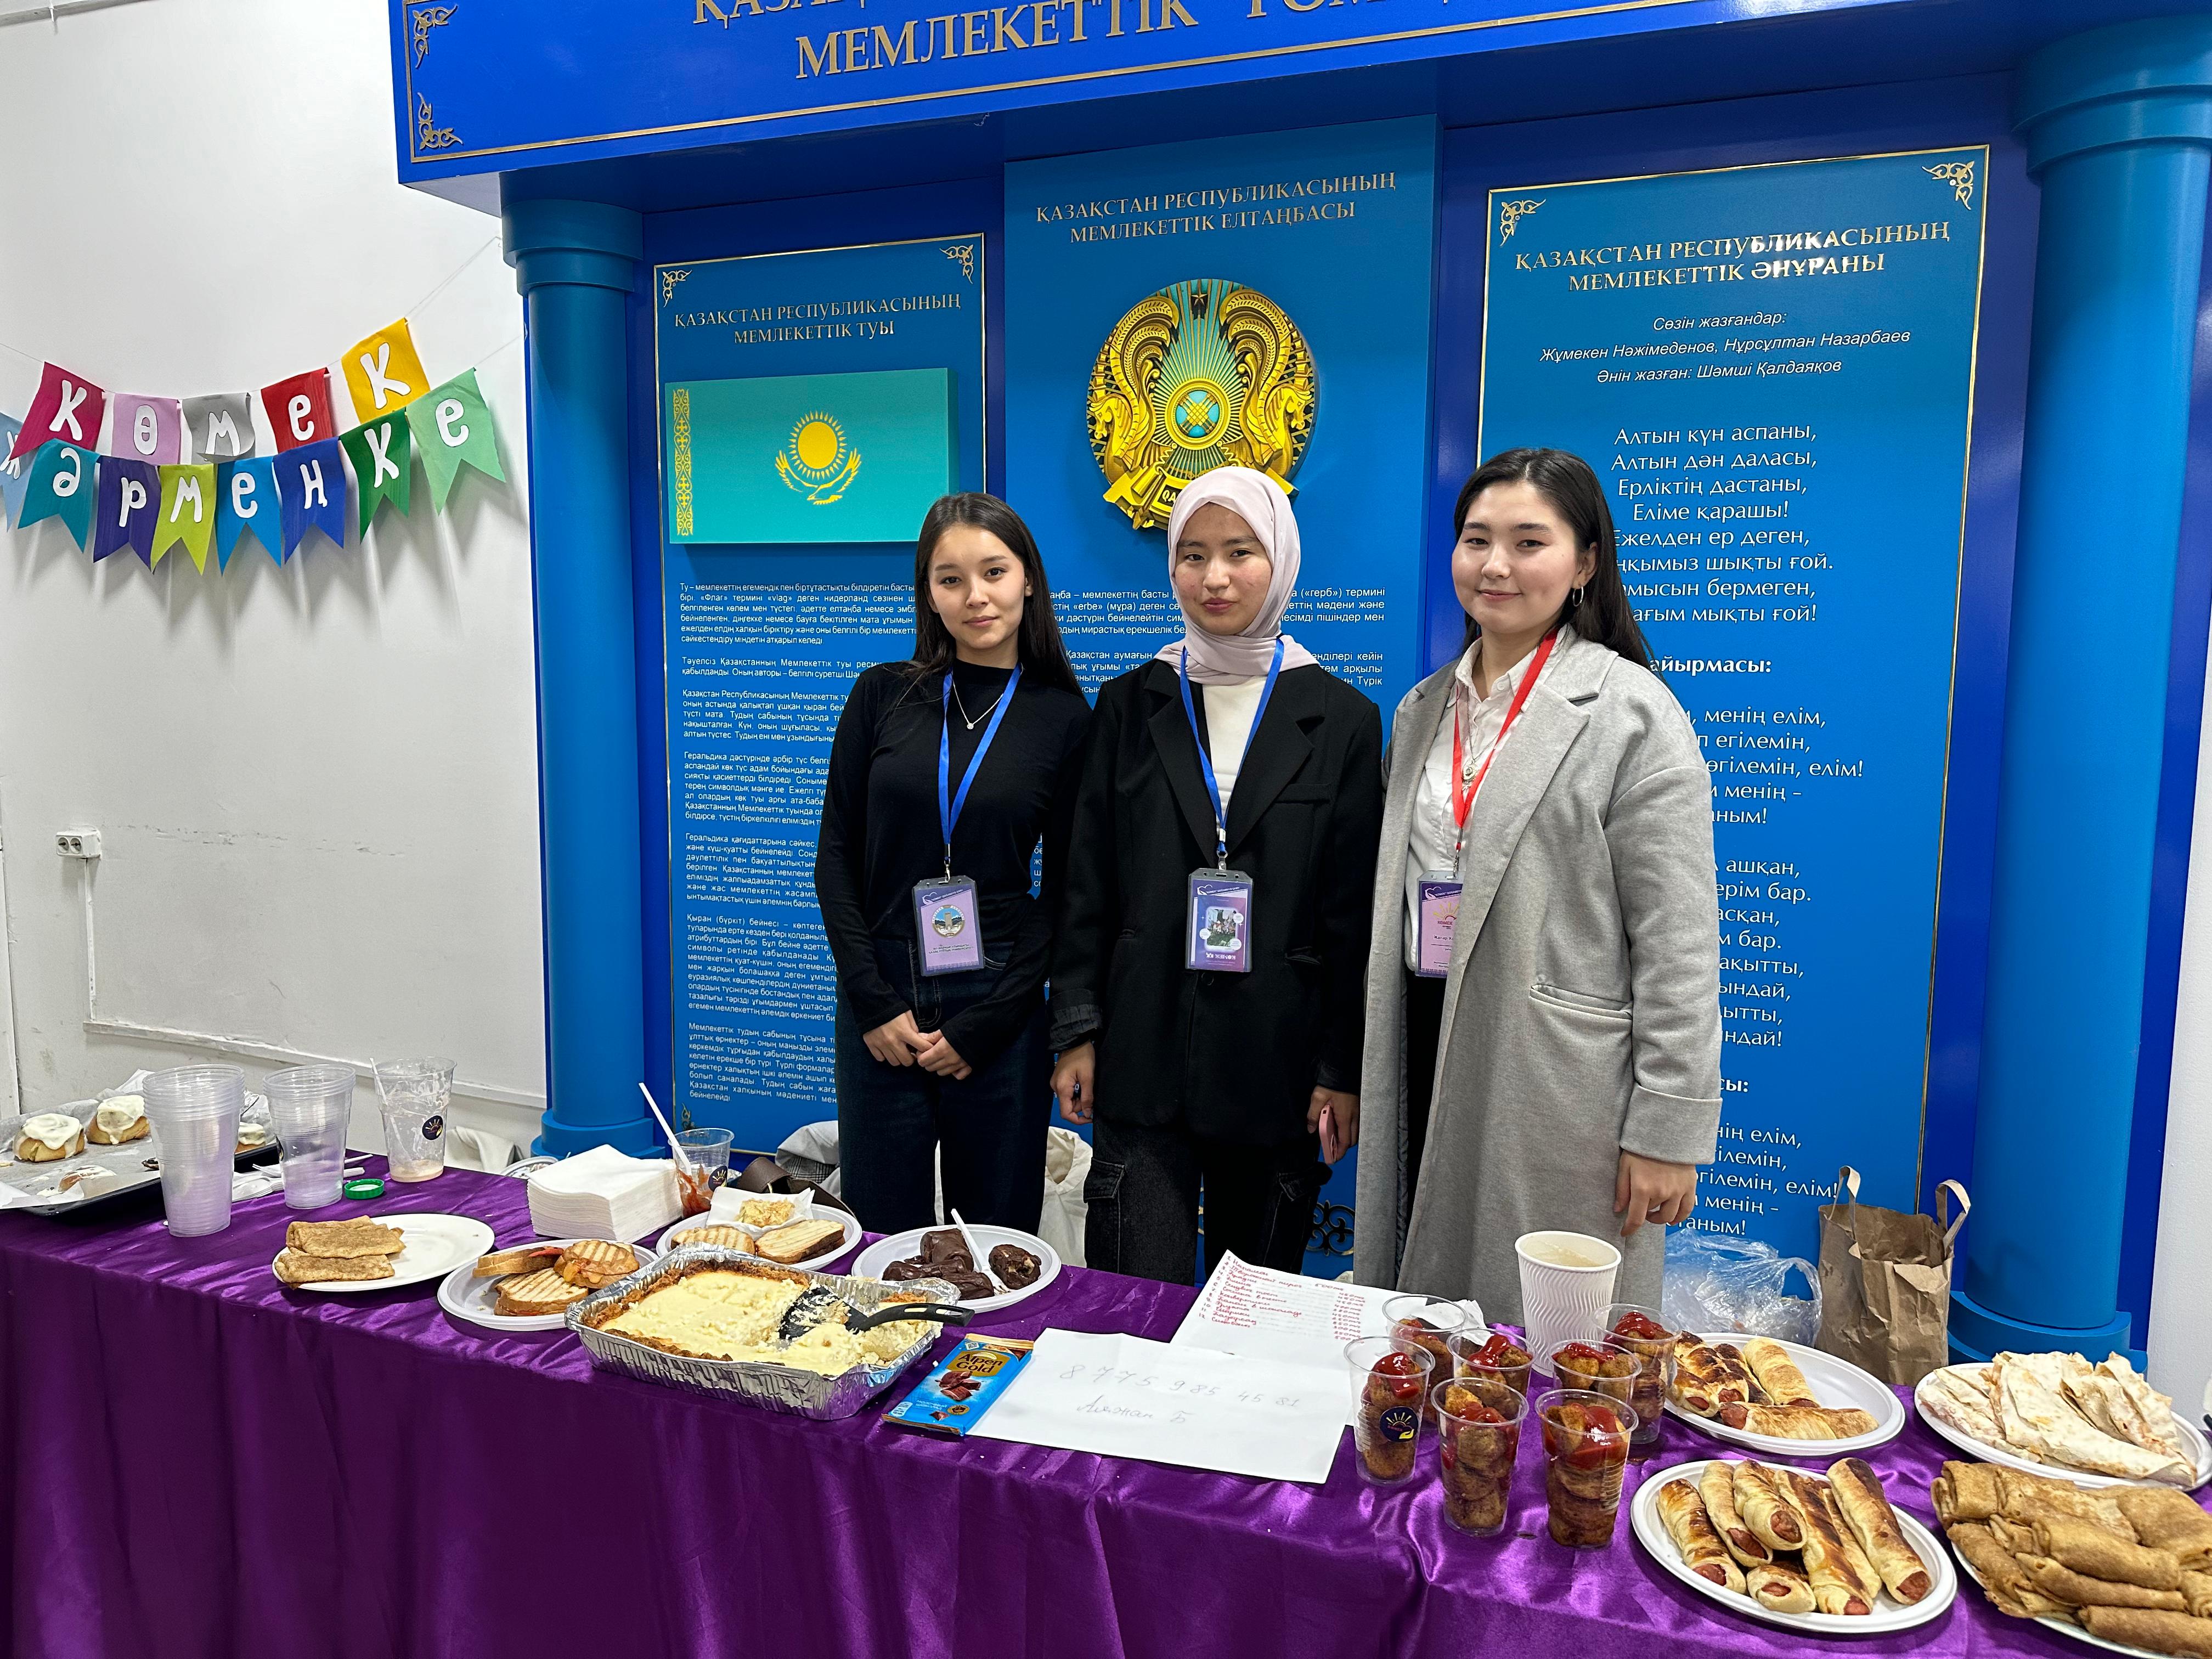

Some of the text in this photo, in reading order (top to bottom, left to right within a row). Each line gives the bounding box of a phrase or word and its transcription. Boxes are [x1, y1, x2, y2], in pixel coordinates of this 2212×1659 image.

[795, 0, 1198, 79] МЕМЛЕКЕТТІК
[1036, 172, 1396, 224] ҚАЗАҚСТАН РЕСПУБЛИКАСЫНЫҢ
[1071, 201, 1355, 243] МЕМЛЕКЕТТІК ЕЛТАҢБАСЫ
[1515, 221, 1950, 272] ҚАЗАҚСТАН РЕСПУБЛИКАСЫНЫҢ
[1569, 253, 1884, 291] МЕМЛЕКЕТТІК ӘНҰРАНЫ
[675, 294, 961, 328] ҚАЗАҚСТАН РЕСПУБЛИКАСЫНЫҢ
[1654, 311, 1787, 330] Сөзін жазғандар:
[735, 320, 894, 343] МЕМЛЕКЕТТІК ТУЫ
[1539, 330, 1911, 364] Жұмекен Нәжімеденов, Нұрсұлтан Назарбаев
[1597, 360, 1842, 383] Әнін жазған: Шәмші Қалдаяқов
[1614, 426, 1816, 447] Алтын күн аспаны,
[1611, 452, 1816, 471] Алтын дән даласы,
[1618, 476, 1807, 500] Ерліктің дастаны,
[1634, 500, 1788, 523] Еліме қарашы!
[1709, 532, 1734, 549] ер
[1740, 531, 1809, 547] деген,
[1616, 553, 1833, 574] ңқымыз шықты ғой.
[680, 583, 689, 592] Ту
[795, 583, 850, 592] біртұтастықты
[851, 583, 889, 593] білдіретін
[1049, 589, 1169, 600] аңба мемлекеттің басты
[1301, 587, 1385, 599] («герб») термині
[1622, 577, 1815, 600] мысын бермеген,
[732, 595, 763, 603] термині
[768, 594, 792, 603] «vlag»
[824, 595, 868, 603] нидерланд
[1073, 602, 1103, 611] «erbe»
[1107, 601, 1136, 612] (мұра)
[1139, 603, 1165, 612] деген
[1317, 602, 1355, 611] мәдени
[1066, 613, 1164, 624] дәстүрін бейнелейтін
[1317, 614, 1361, 623] пішіндер
[1633, 604, 1816, 624] ағым мықты ғой!
[681, 635, 733, 645] сәйкестендіру
[766, 637, 797, 645] атқарып
[1081, 627, 1125, 635] мирастық
[1126, 627, 1172, 636] ерекшелік
[1114, 652, 1153, 661] аумағын
[1311, 651, 1383, 662] енділері кейін
[1650, 656, 1771, 676] айырмасы:
[1091, 663, 1120, 672] ұғымы
[1343, 665, 1383, 675] арқылы
[1356, 676, 1383, 687] Түрік
[1705, 706, 1765, 726] менің
[1773, 707, 1825, 729] елім,
[1716, 731, 1810, 753] егілемін,
[1706, 756, 1863, 778] өгілемін, елім!
[1724, 782, 1786, 802] менің
[1726, 860, 1799, 879] ашқан,
[1716, 881, 1811, 905] ерім бар.
[1718, 907, 1780, 927] асқан,
[1739, 929, 1781, 952] бар.
[1719, 957, 1804, 978] ақытты,
[1719, 982, 1791, 1002] ындай,
[1719, 1006, 1782, 1026] ытты,
[1722, 1030, 1782, 1047] ндай!
[1717, 1122, 1801, 1149] нің елім,
[1716, 1146, 1787, 1171] ілемін,
[1696, 1168, 1837, 1198] гілемін, елім!
[1705, 1196, 1764, 1216] менің
[956, 1362, 995, 1373] Gold
[958, 1354, 1003, 1366] Alpen
